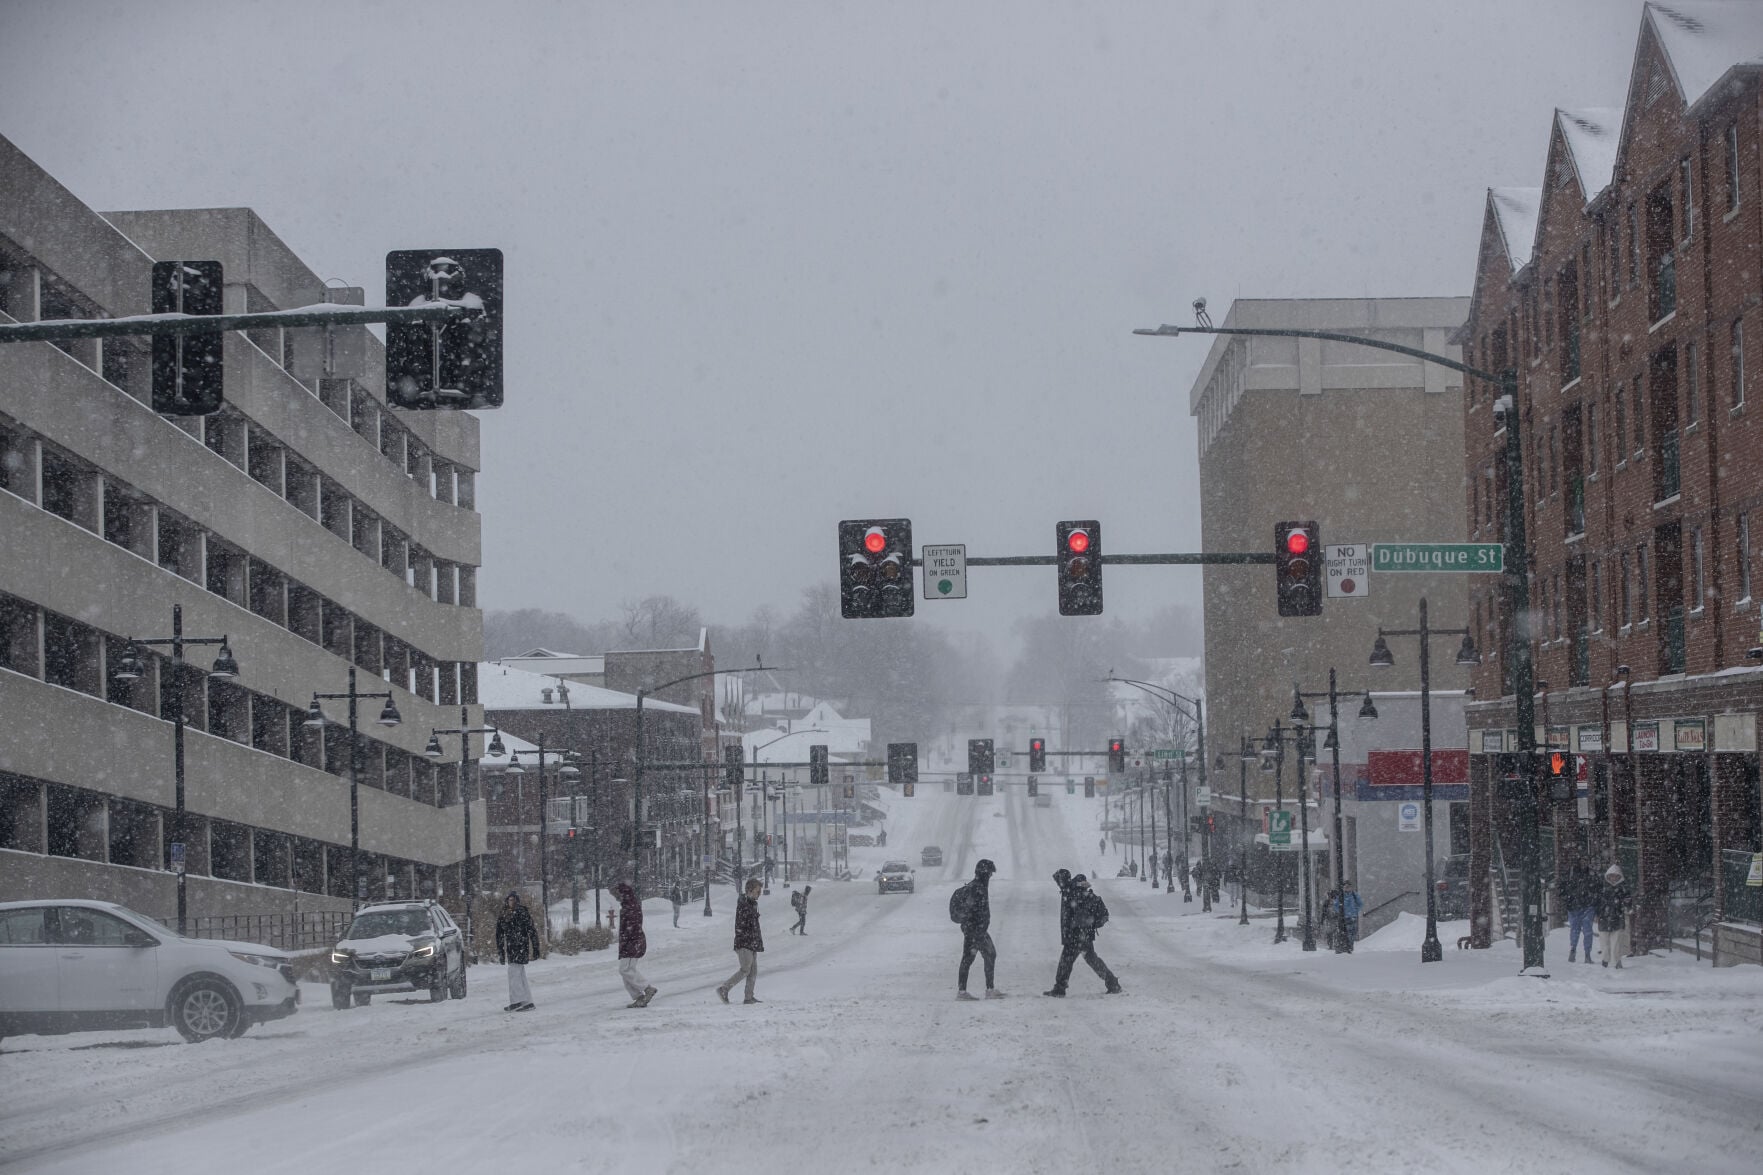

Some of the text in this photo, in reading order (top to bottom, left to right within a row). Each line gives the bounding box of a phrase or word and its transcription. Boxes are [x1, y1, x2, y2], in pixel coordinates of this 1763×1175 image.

[1337, 547, 1355, 557] NO
[933, 558, 956, 567] YIELD
[1327, 557, 1367, 568] RIGHT TURN
[1380, 548, 1496, 567] Dubuque St
[940, 568, 960, 576] GREEN
[1330, 567, 1365, 577] ON RED
